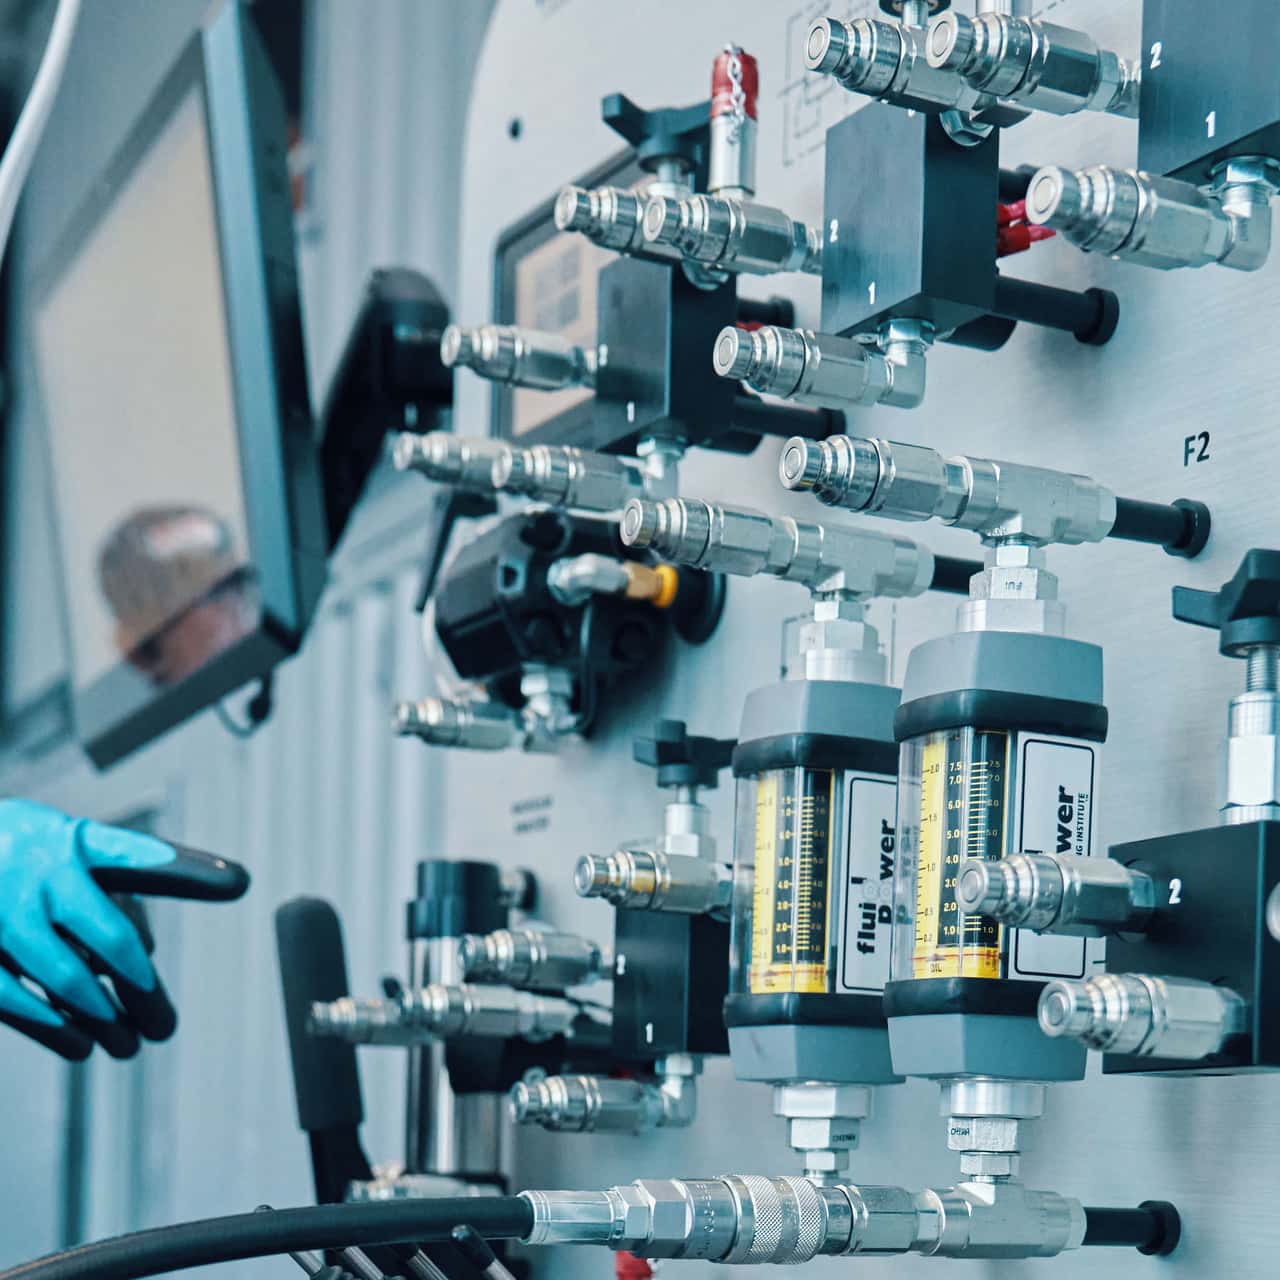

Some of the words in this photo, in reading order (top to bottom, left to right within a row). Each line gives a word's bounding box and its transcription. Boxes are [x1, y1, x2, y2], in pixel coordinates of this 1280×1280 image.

[1150, 42, 1161, 70] 2
[1205, 111, 1215, 138] 1
[829, 218, 839, 243] 2
[868, 281, 875, 305] 1
[1184, 431, 1210, 467] F2
[949, 761, 962, 772] 7.5
[949, 775, 962, 785] 7.0
[948, 800, 961, 810] 6.0
[1075, 792, 1087, 842] INSTITUTE
[946, 830, 960, 839] 5.0
[945, 854, 959, 864] 4.0
[1169, 878, 1182, 904] 2
[943, 902, 957, 912] 2.0
[943, 926, 956, 935] 1.0
